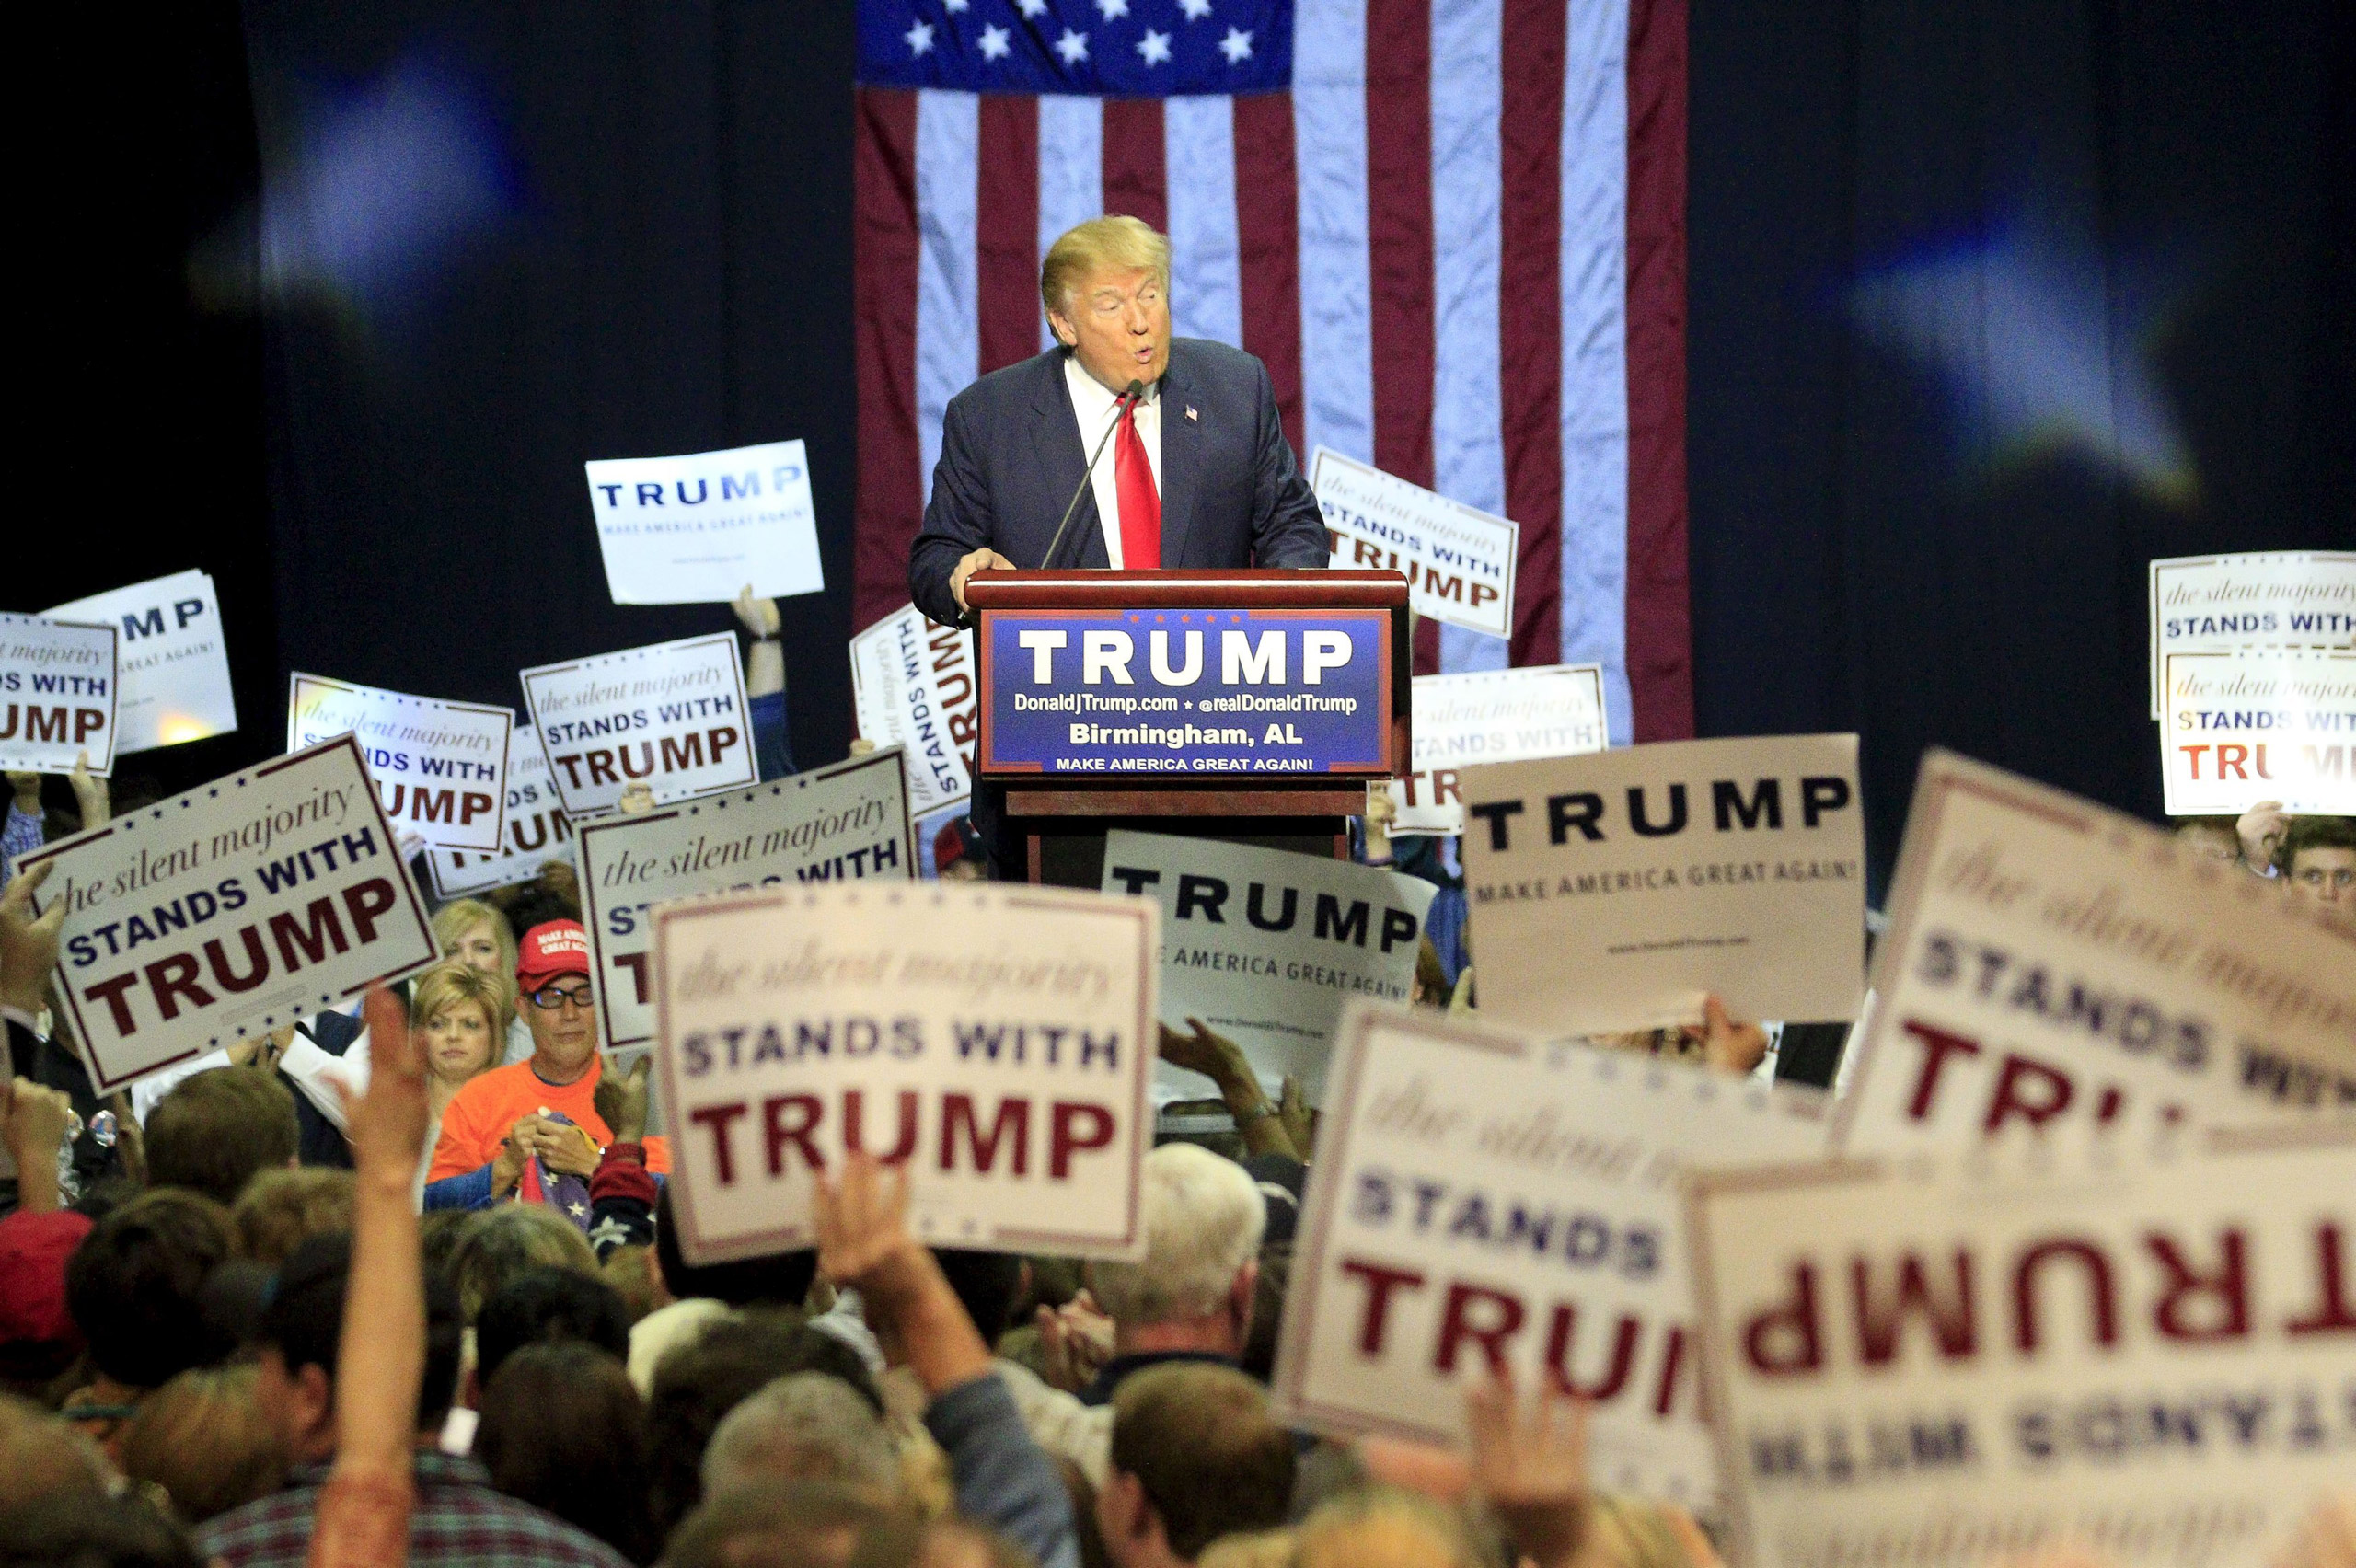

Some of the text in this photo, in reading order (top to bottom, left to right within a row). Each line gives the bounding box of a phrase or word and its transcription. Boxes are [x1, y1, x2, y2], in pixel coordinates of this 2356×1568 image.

[598, 466, 802, 507] TRUMP
[1322, 501, 1500, 578] STANDS WITH
[2166, 611, 2279, 638] STANDS
[31, 673, 108, 697] WITH
[1018, 629, 1353, 686] TRUMP
[548, 695, 733, 744] STANDS WITH
[897, 618, 958, 794] STANDS WITH
[1014, 693, 1357, 716] DonaldJTrump.com @realDonaldTrump
[1069, 723, 1303, 749] Birmingham, AL
[2304, 710, 2356, 731] WIT
[421, 756, 495, 782] WITH
[556, 726, 738, 790] TRUMP
[1056, 757, 1314, 771] MAKE AMERICA GREAT AGAIN!
[1413, 724, 1594, 758] TANDS WITH
[604, 795, 890, 887] the silent majority
[1470, 775, 1850, 852] TRUMP
[64, 782, 356, 916] he silent majority
[68, 878, 248, 968] STANDS
[257, 827, 379, 895] WITH
[1112, 866, 1418, 954] TRUMP
[1475, 880, 1549, 905] MAKE
[1557, 867, 1680, 898] AMERICA
[1687, 861, 1766, 888] GREAT
[82, 876, 397, 1038] TRUMP
[1174, 946, 1278, 977] AMERICA
[1287, 963, 1347, 989] GREAT
[1917, 928, 2209, 1072] STANDS
[682, 1016, 1121, 1080] STANDS WITH
[688, 1089, 1117, 1189] TRUMP
[1353, 1167, 1661, 1279] STANDS
[1742, 1216, 2356, 1377] TRUMP
[1339, 1256, 1695, 1419] TRU
